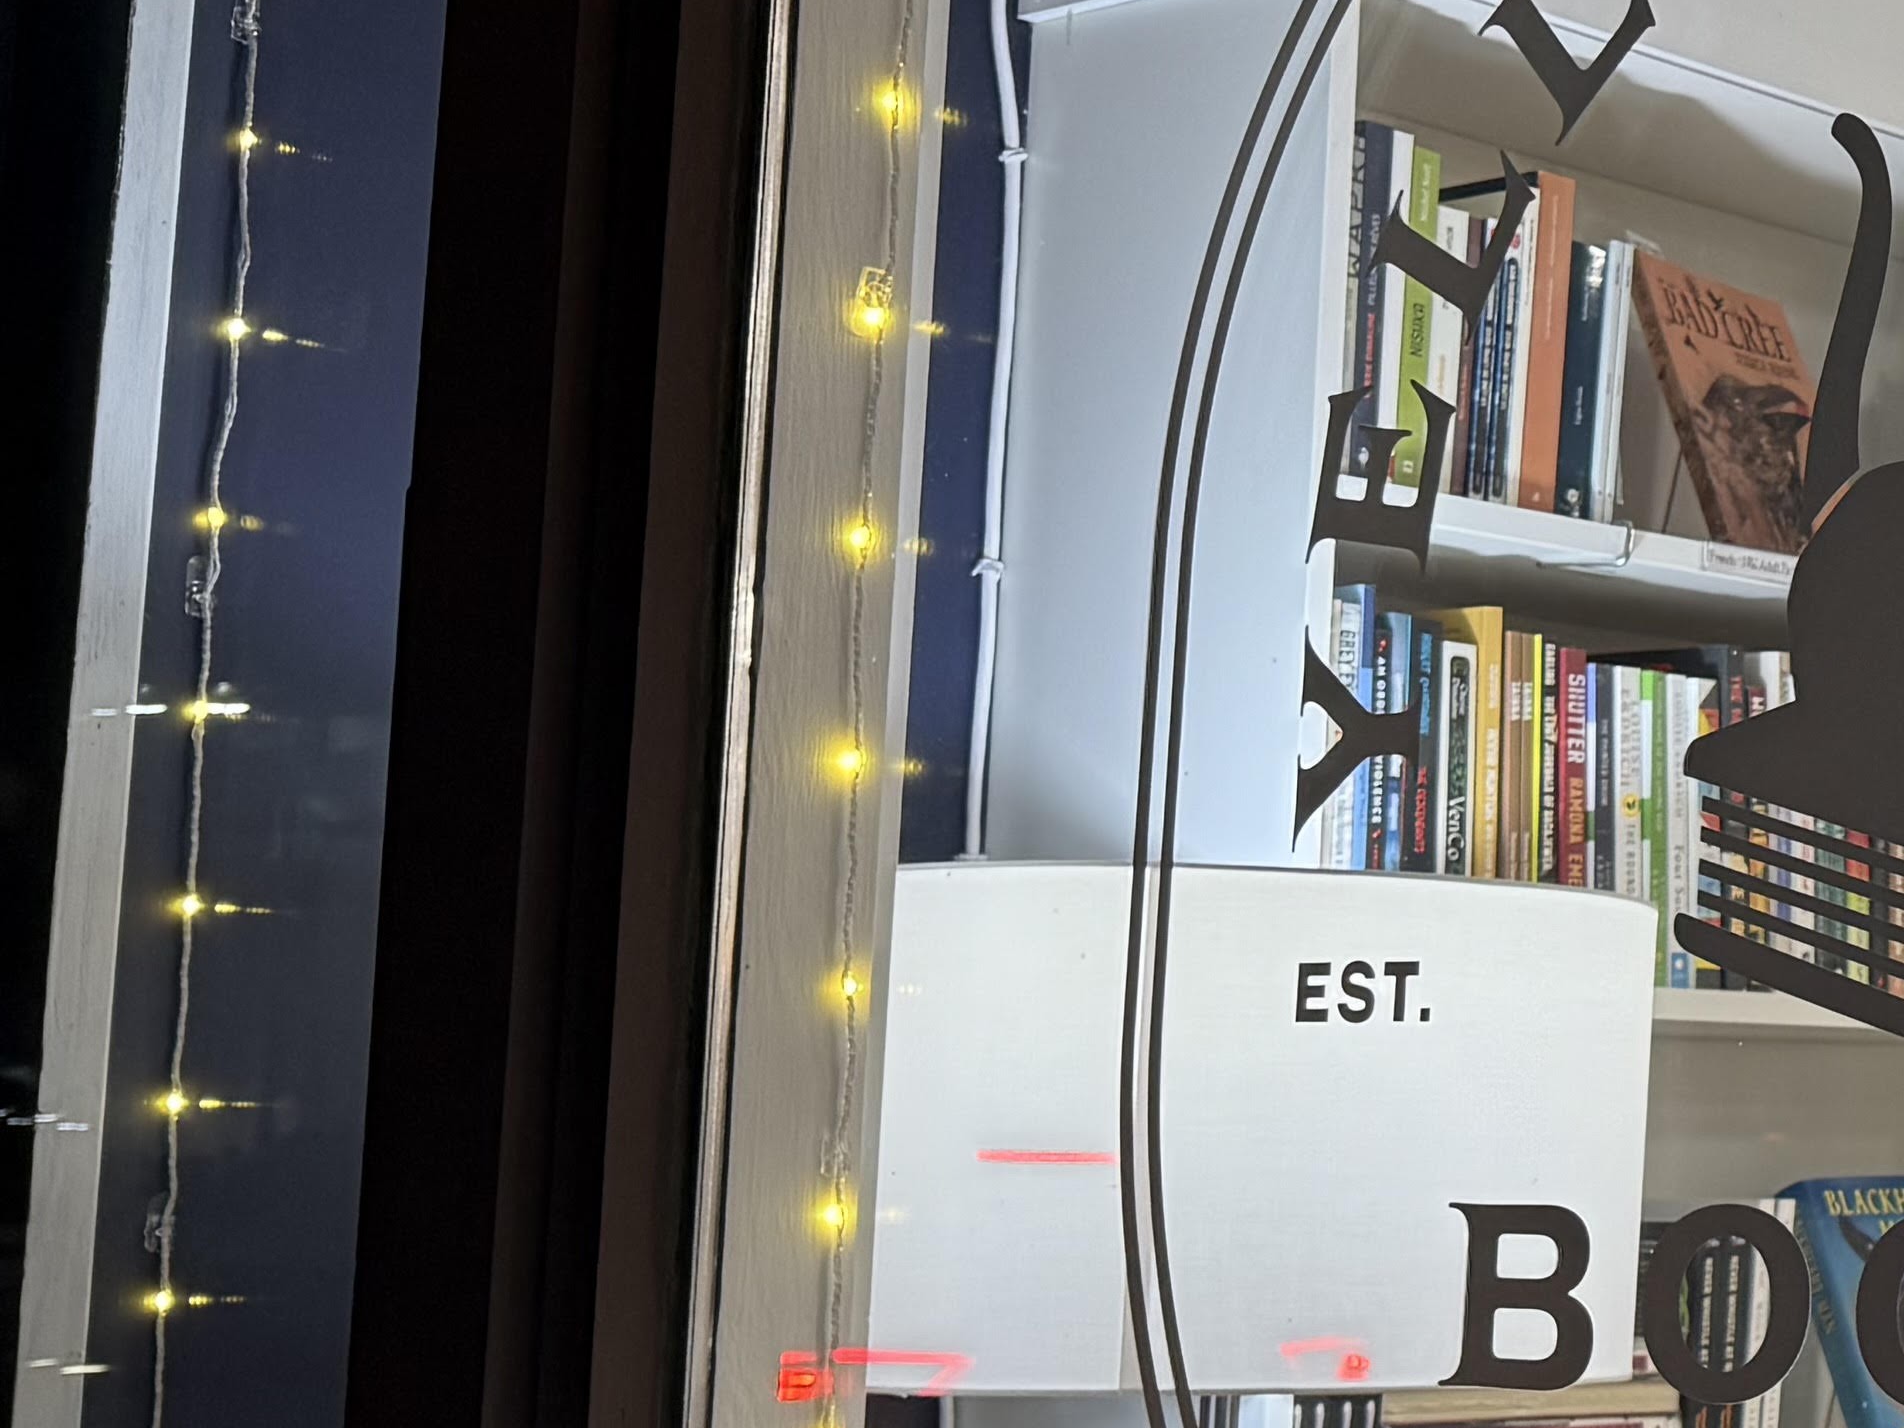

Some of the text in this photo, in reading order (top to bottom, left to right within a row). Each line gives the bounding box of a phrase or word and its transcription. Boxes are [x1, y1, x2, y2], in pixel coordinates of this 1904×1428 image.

[1662, 276, 1792, 363] BAD CREE
[1567, 674, 1586, 764] SHUTTER
[1447, 797, 1466, 862] VenCo
[1569, 777, 1584, 844] RAMONA
[1294, 960, 1432, 1025] EST.
